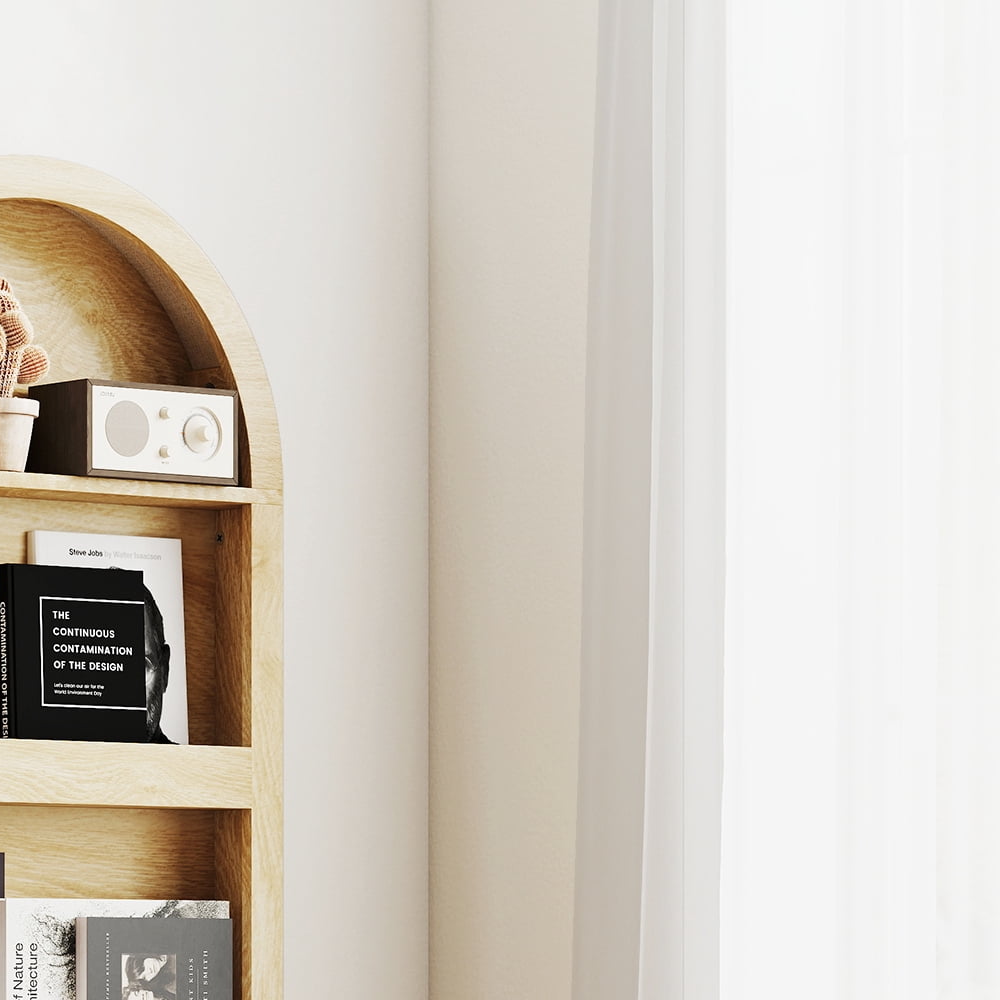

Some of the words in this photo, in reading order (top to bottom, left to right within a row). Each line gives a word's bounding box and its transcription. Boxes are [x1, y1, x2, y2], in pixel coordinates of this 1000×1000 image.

[68, 548, 87, 557] Steve
[88, 549, 103, 557] Jobs
[52, 610, 71, 620] THE
[52, 627, 116, 639] CONTINUOUS
[0, 601, 8, 681] CONTAMINATION
[53, 643, 133, 656] CONTAMINATION
[53, 660, 67, 670] OF
[69, 660, 87, 671] THE
[88, 661, 124, 672] DESIGN
[1, 683, 8, 696] OF
[1, 697, 9, 716] THE
[13, 942, 24, 990] Nature
